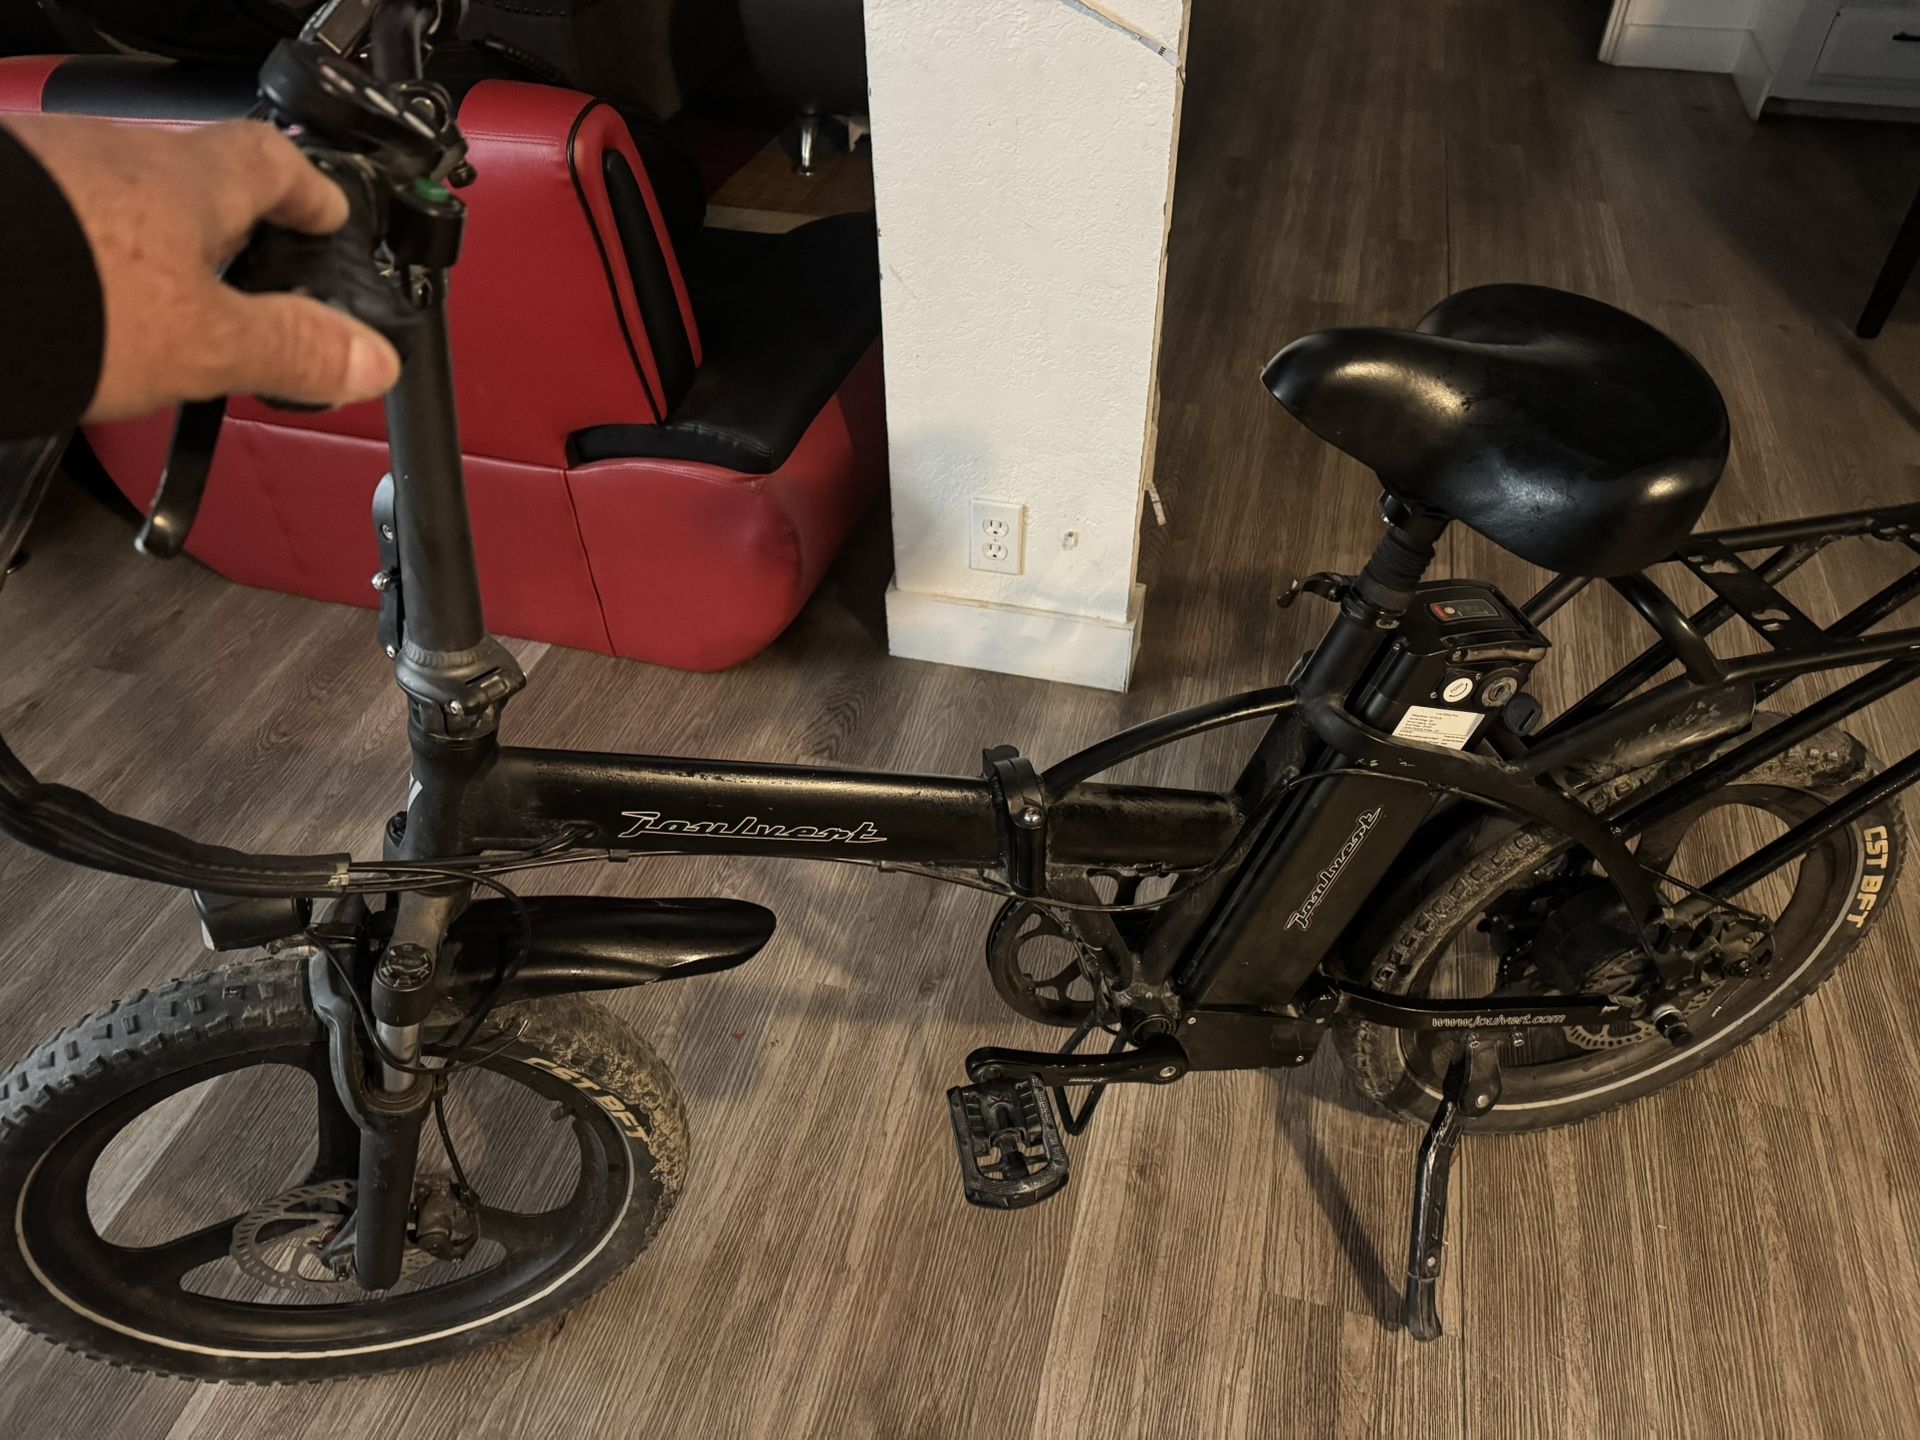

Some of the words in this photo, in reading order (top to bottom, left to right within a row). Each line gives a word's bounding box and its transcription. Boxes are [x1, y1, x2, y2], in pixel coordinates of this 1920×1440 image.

[618, 811, 887, 843] Joulvert
[1864, 825, 1889, 869] CST
[1285, 806, 1383, 930] Joulvert
[1846, 874, 1885, 929] BFT
[1431, 1013, 1567, 1029] www.joulvert.com
[525, 1057, 602, 1091] CST
[593, 1095, 650, 1142] BFT
